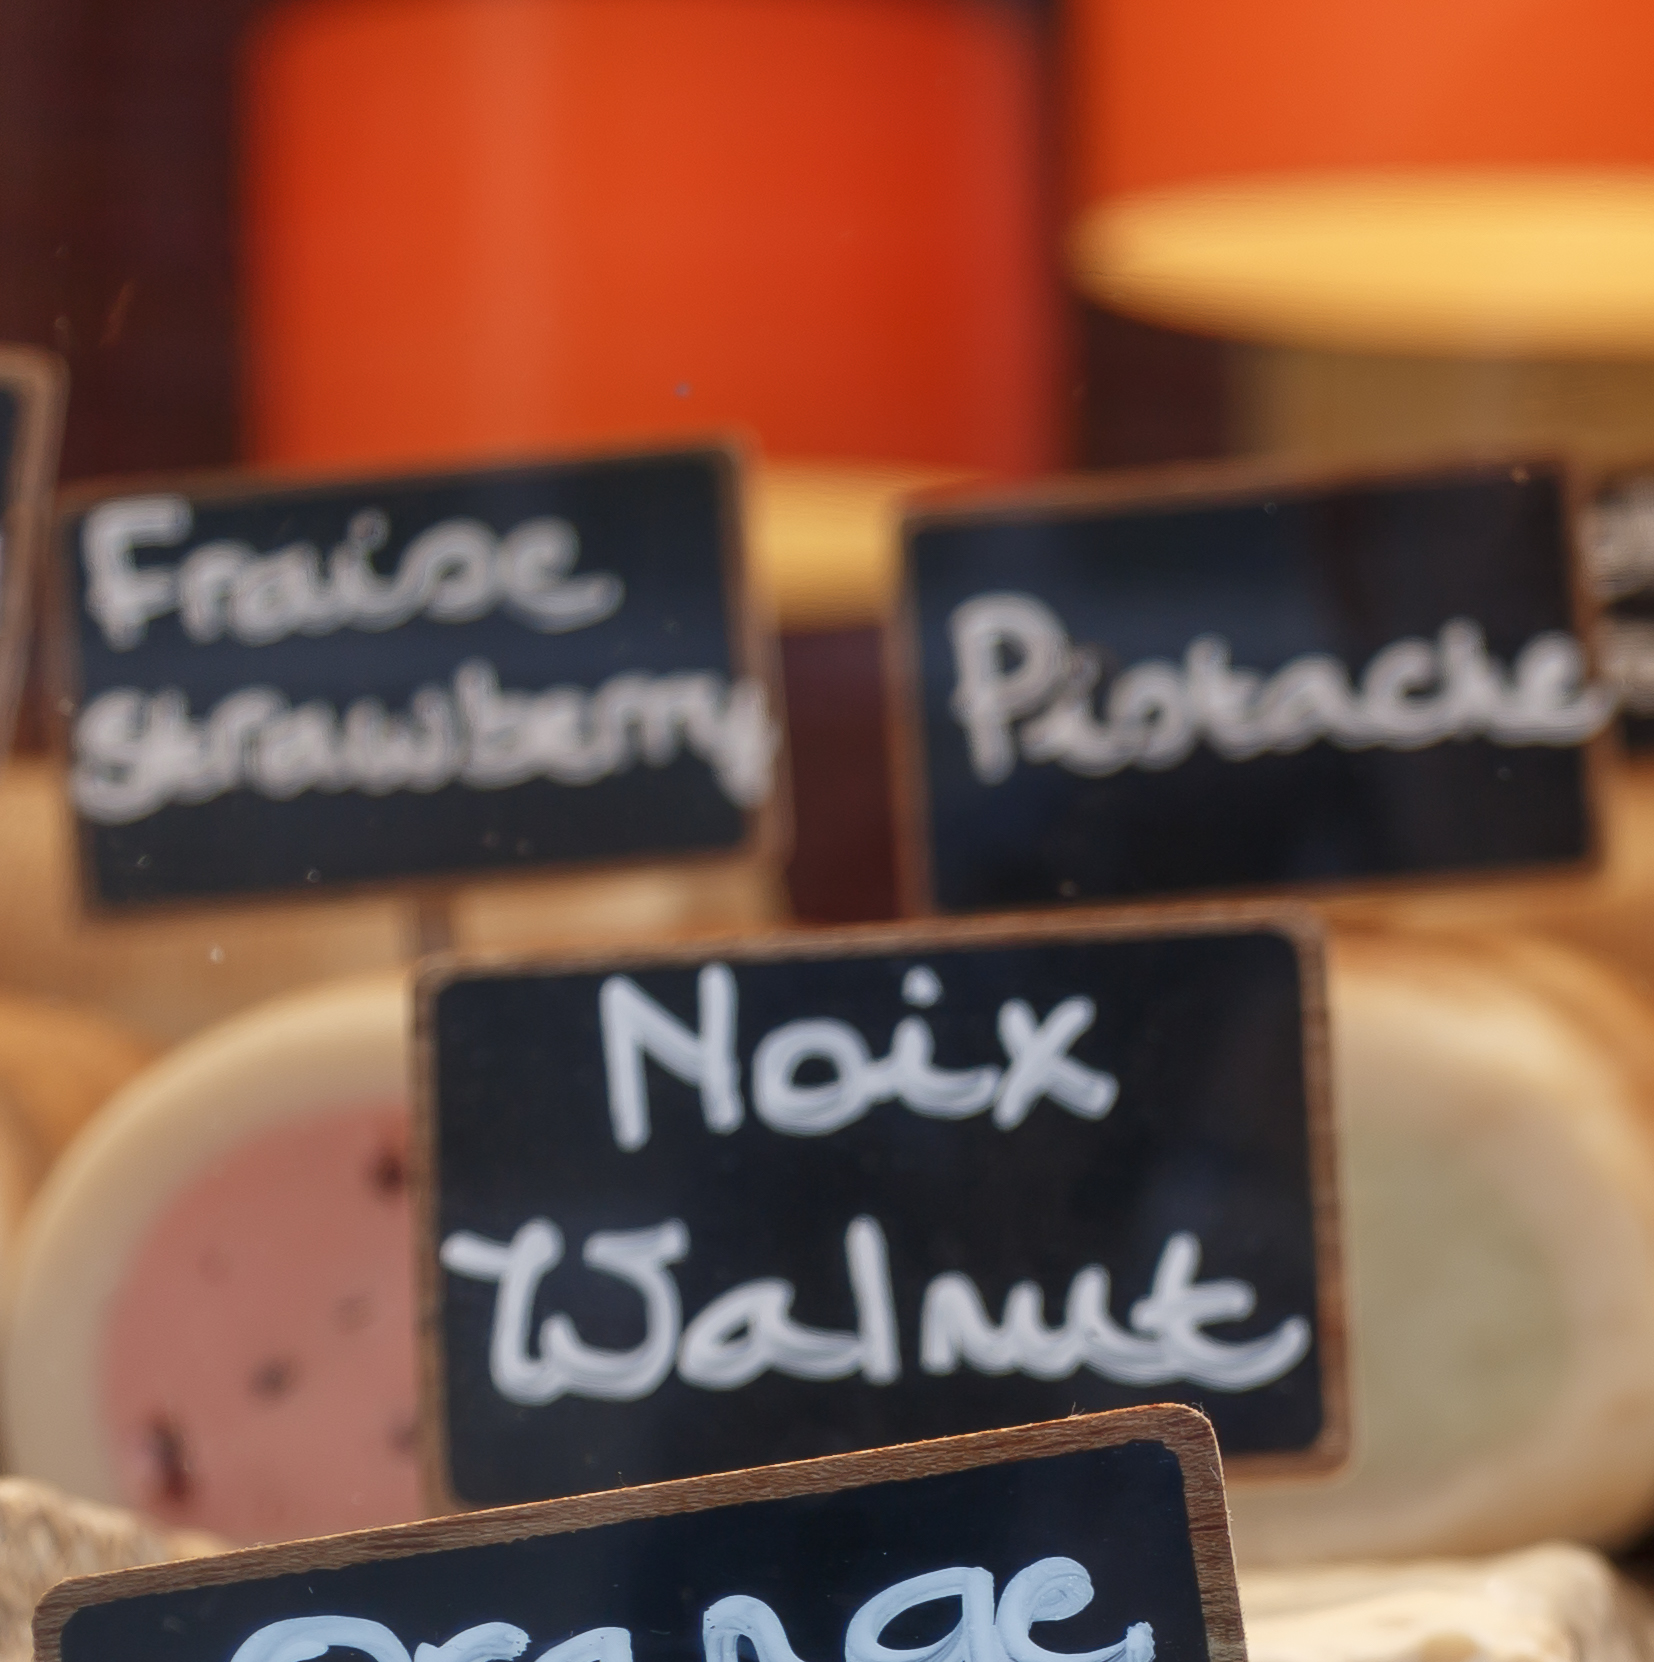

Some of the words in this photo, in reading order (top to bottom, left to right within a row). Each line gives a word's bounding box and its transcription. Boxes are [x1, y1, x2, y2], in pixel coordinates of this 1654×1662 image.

[81, 493, 624, 650] Fraise
[948, 592, 1623, 784] Pistache
[599, 962, 1119, 1152] Noix
[439, 1214, 1312, 1406] Walnut
